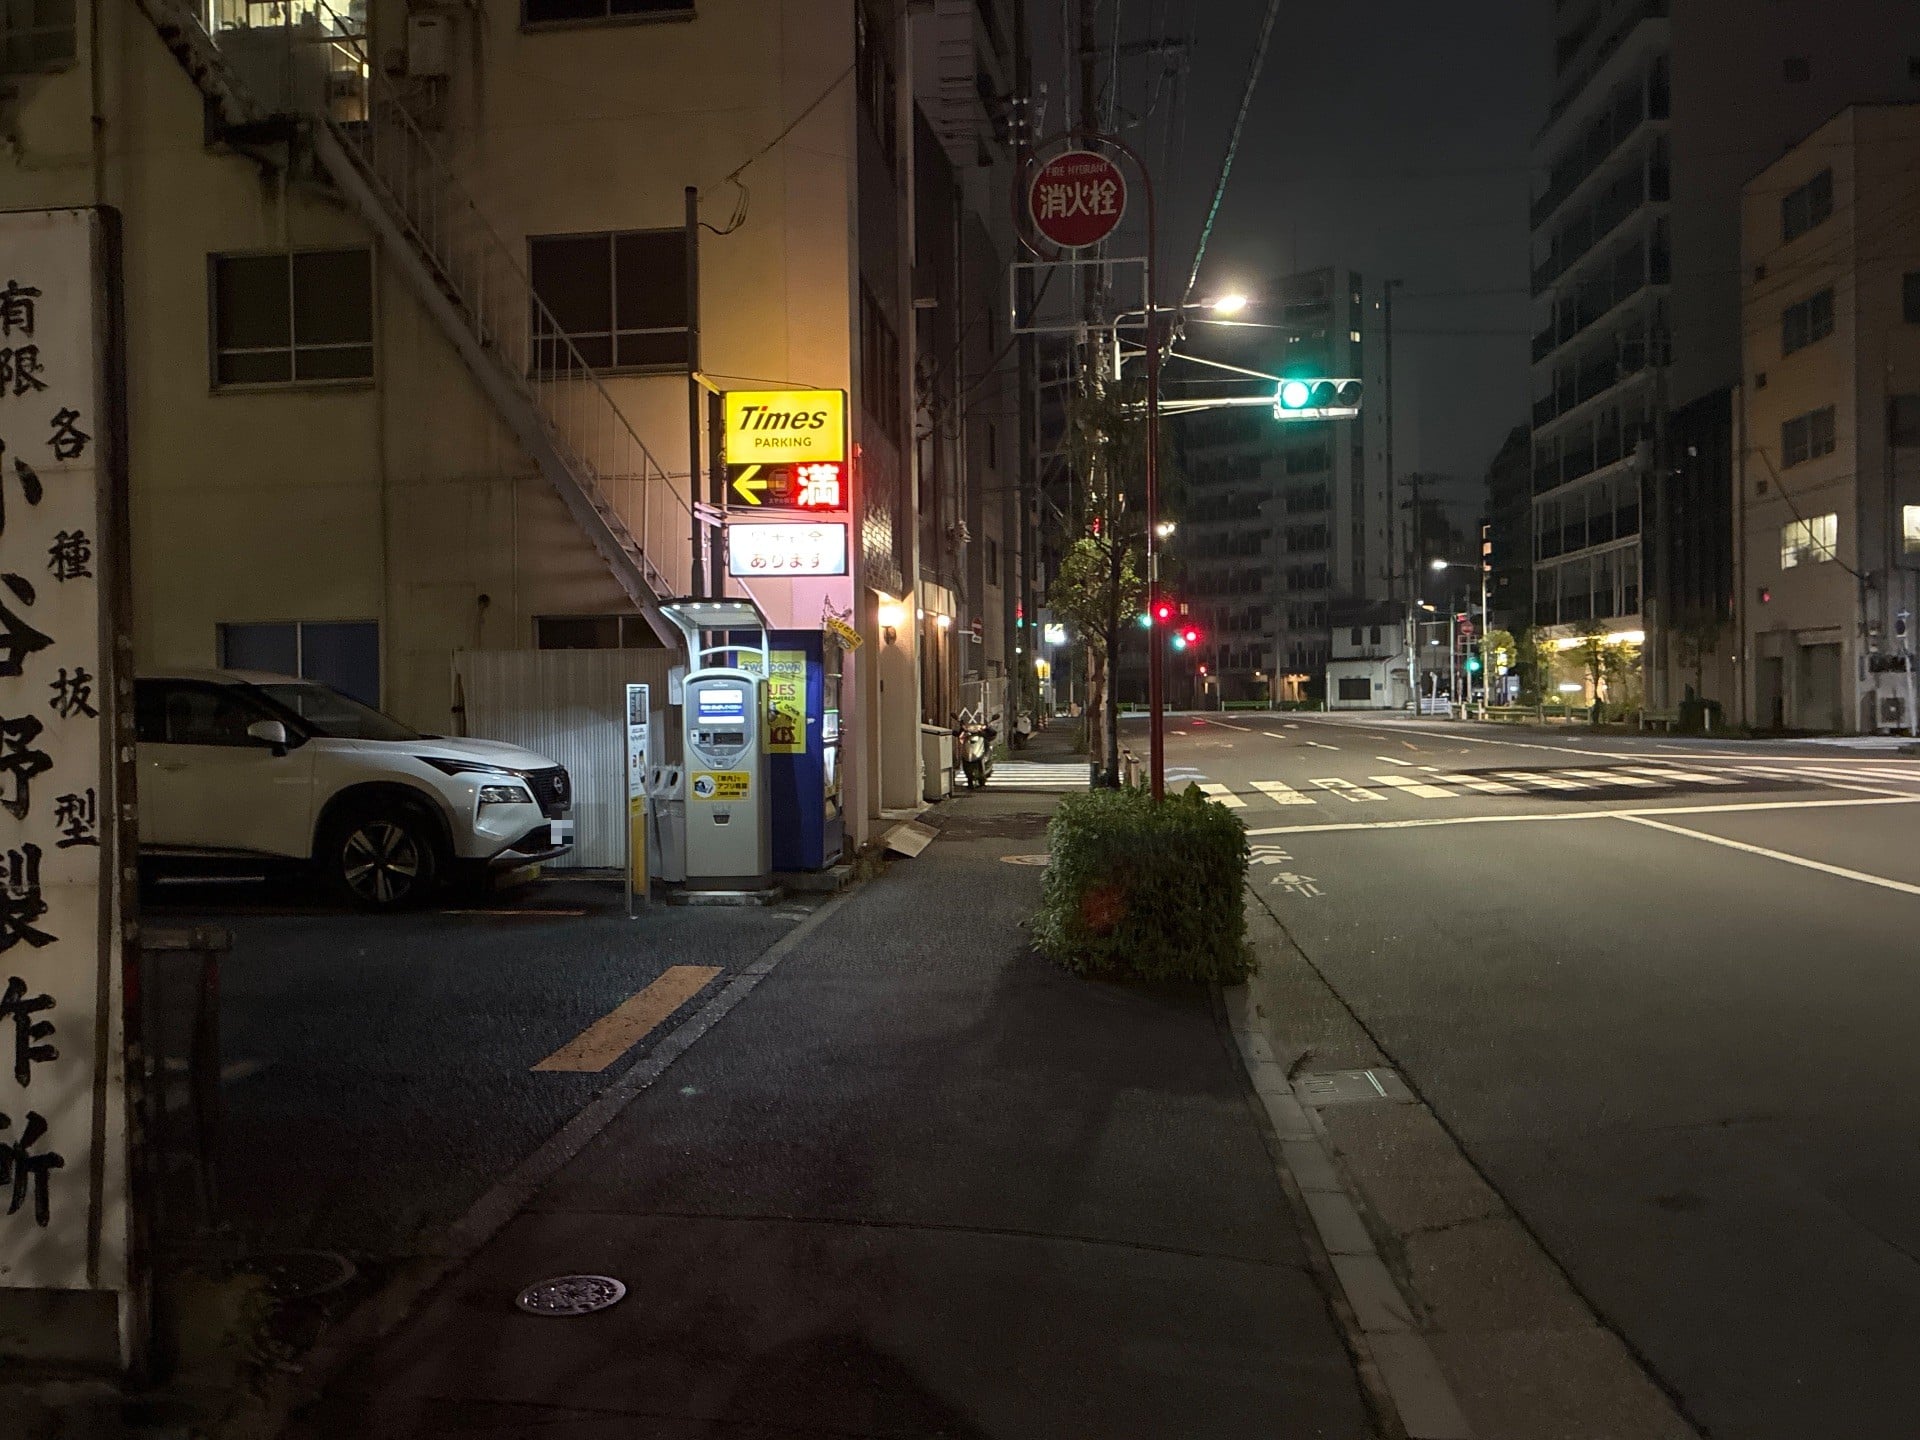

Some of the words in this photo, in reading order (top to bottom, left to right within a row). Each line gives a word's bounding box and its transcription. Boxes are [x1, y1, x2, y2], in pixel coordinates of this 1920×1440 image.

[1040, 179, 1117, 220] 消火栓
[738, 406, 828, 430] Times
[755, 436, 813, 448] PARKING
[797, 463, 840, 506] 満
[750, 552, 821, 569] あります
